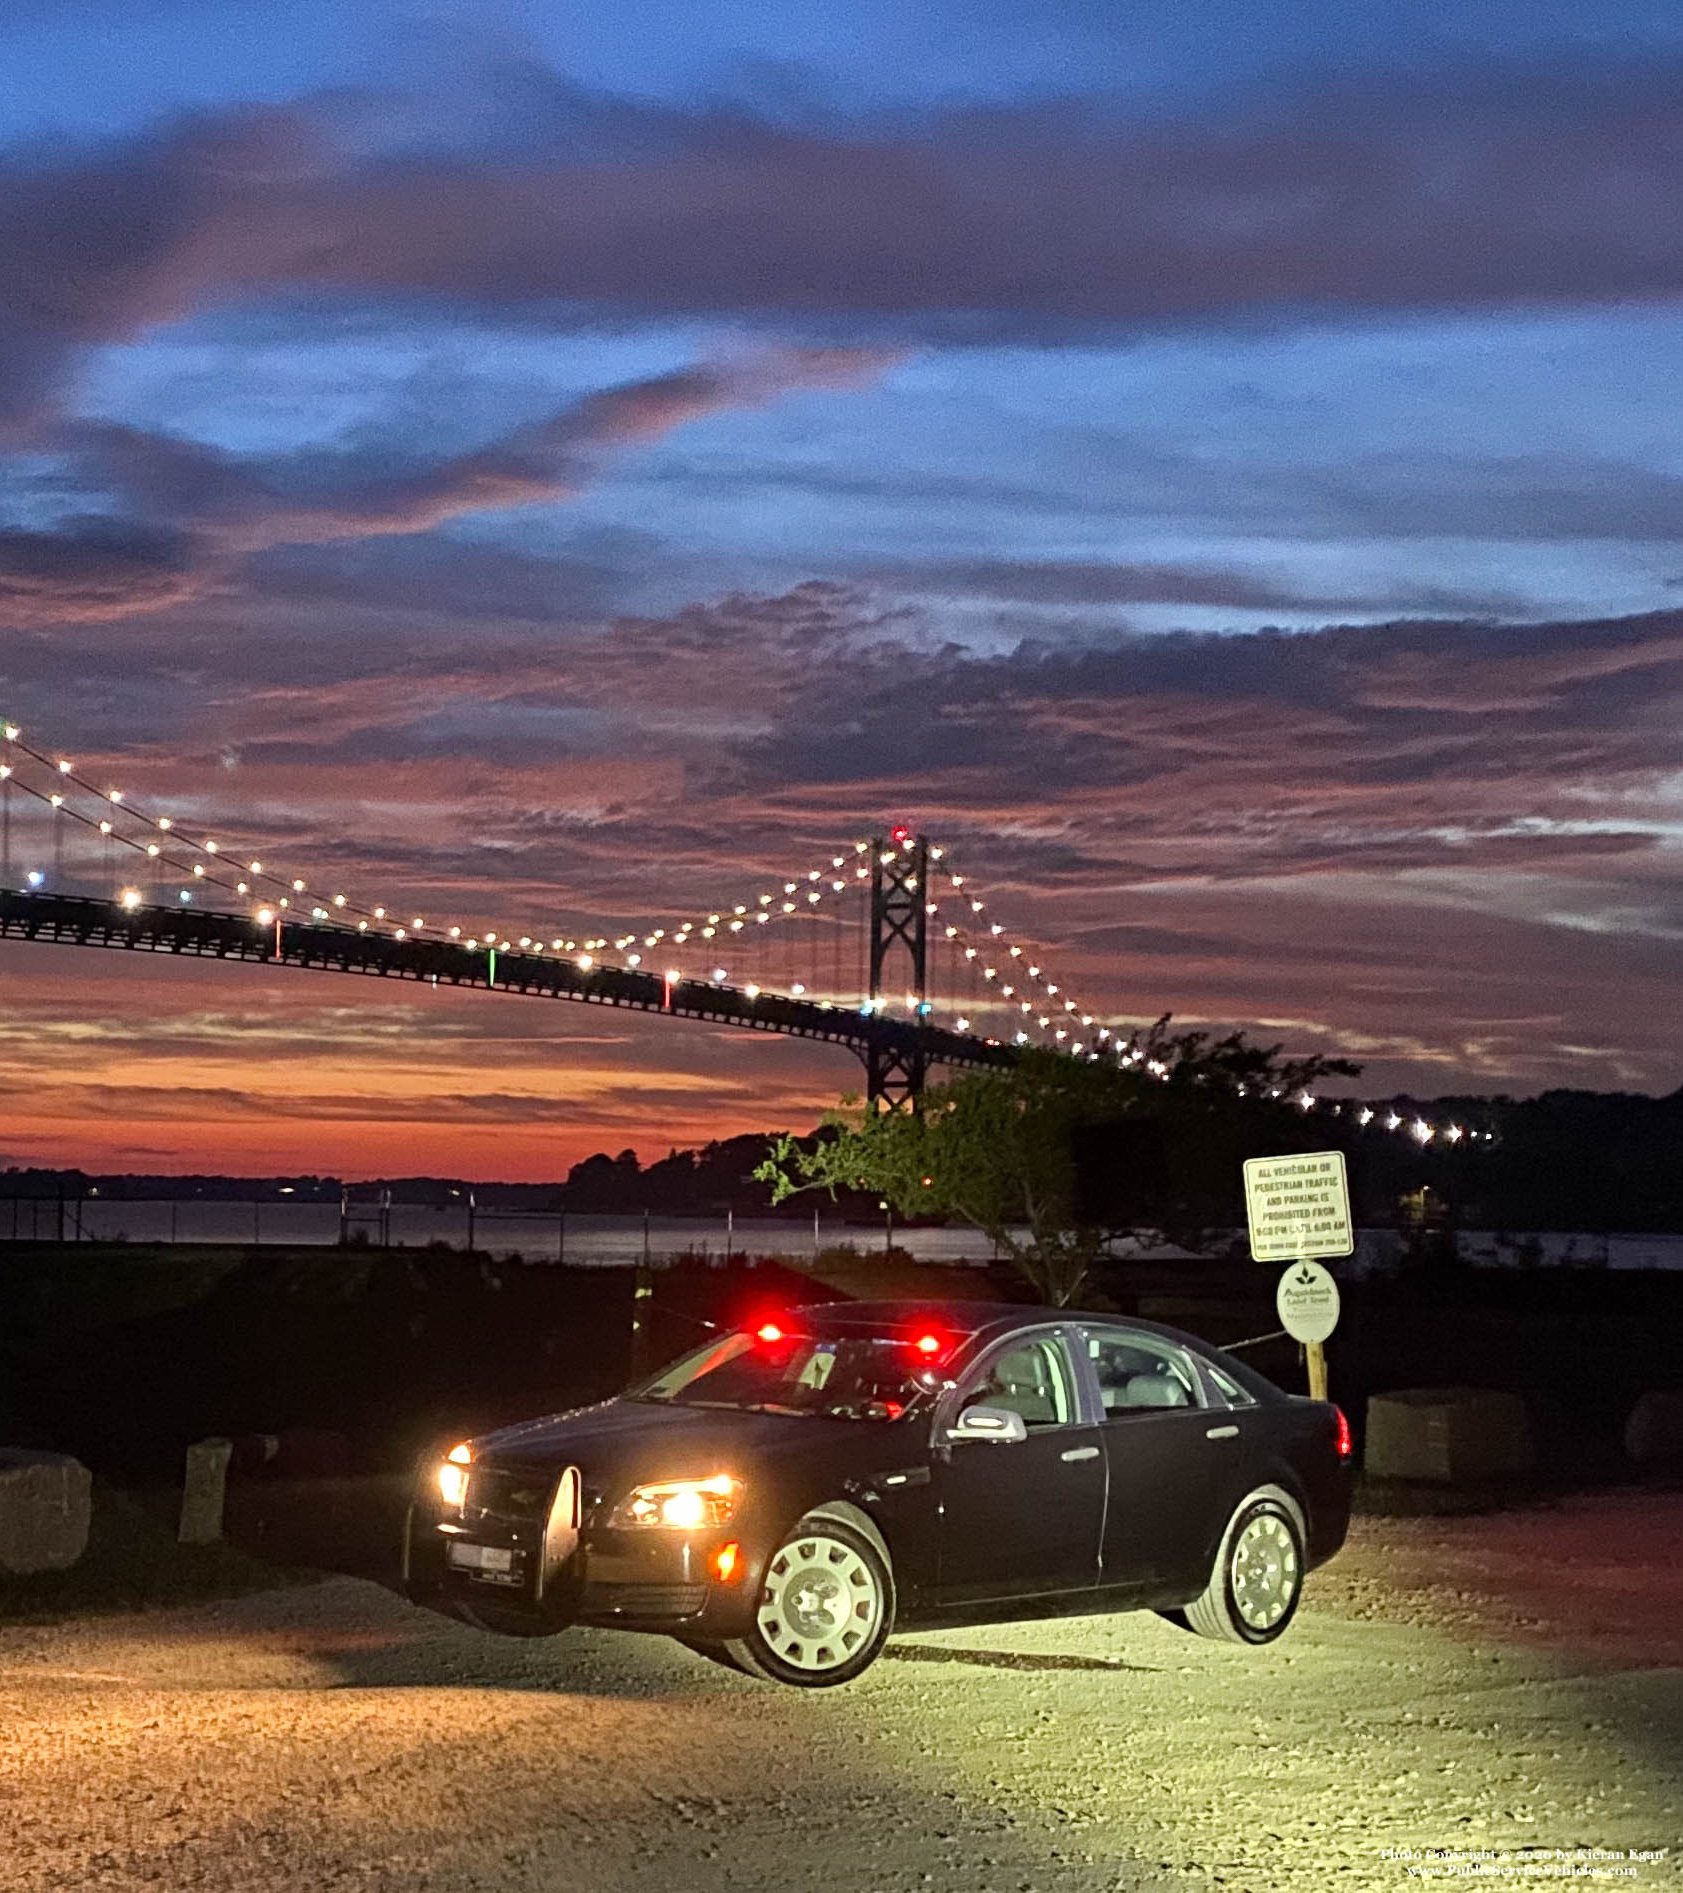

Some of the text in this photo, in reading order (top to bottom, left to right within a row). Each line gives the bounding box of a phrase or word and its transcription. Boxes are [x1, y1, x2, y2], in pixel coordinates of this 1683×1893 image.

[1259, 1162, 1331, 1178] ALL VEHICULAR OR
[1254, 1177, 1338, 1193] PEDESTRIAN TRAFFIC
[1267, 1192, 1329, 1206] AND PARKING IS
[1263, 1207, 1335, 1221] PROHIBITED FROM
[1334, 1220, 1346, 1231] AM
